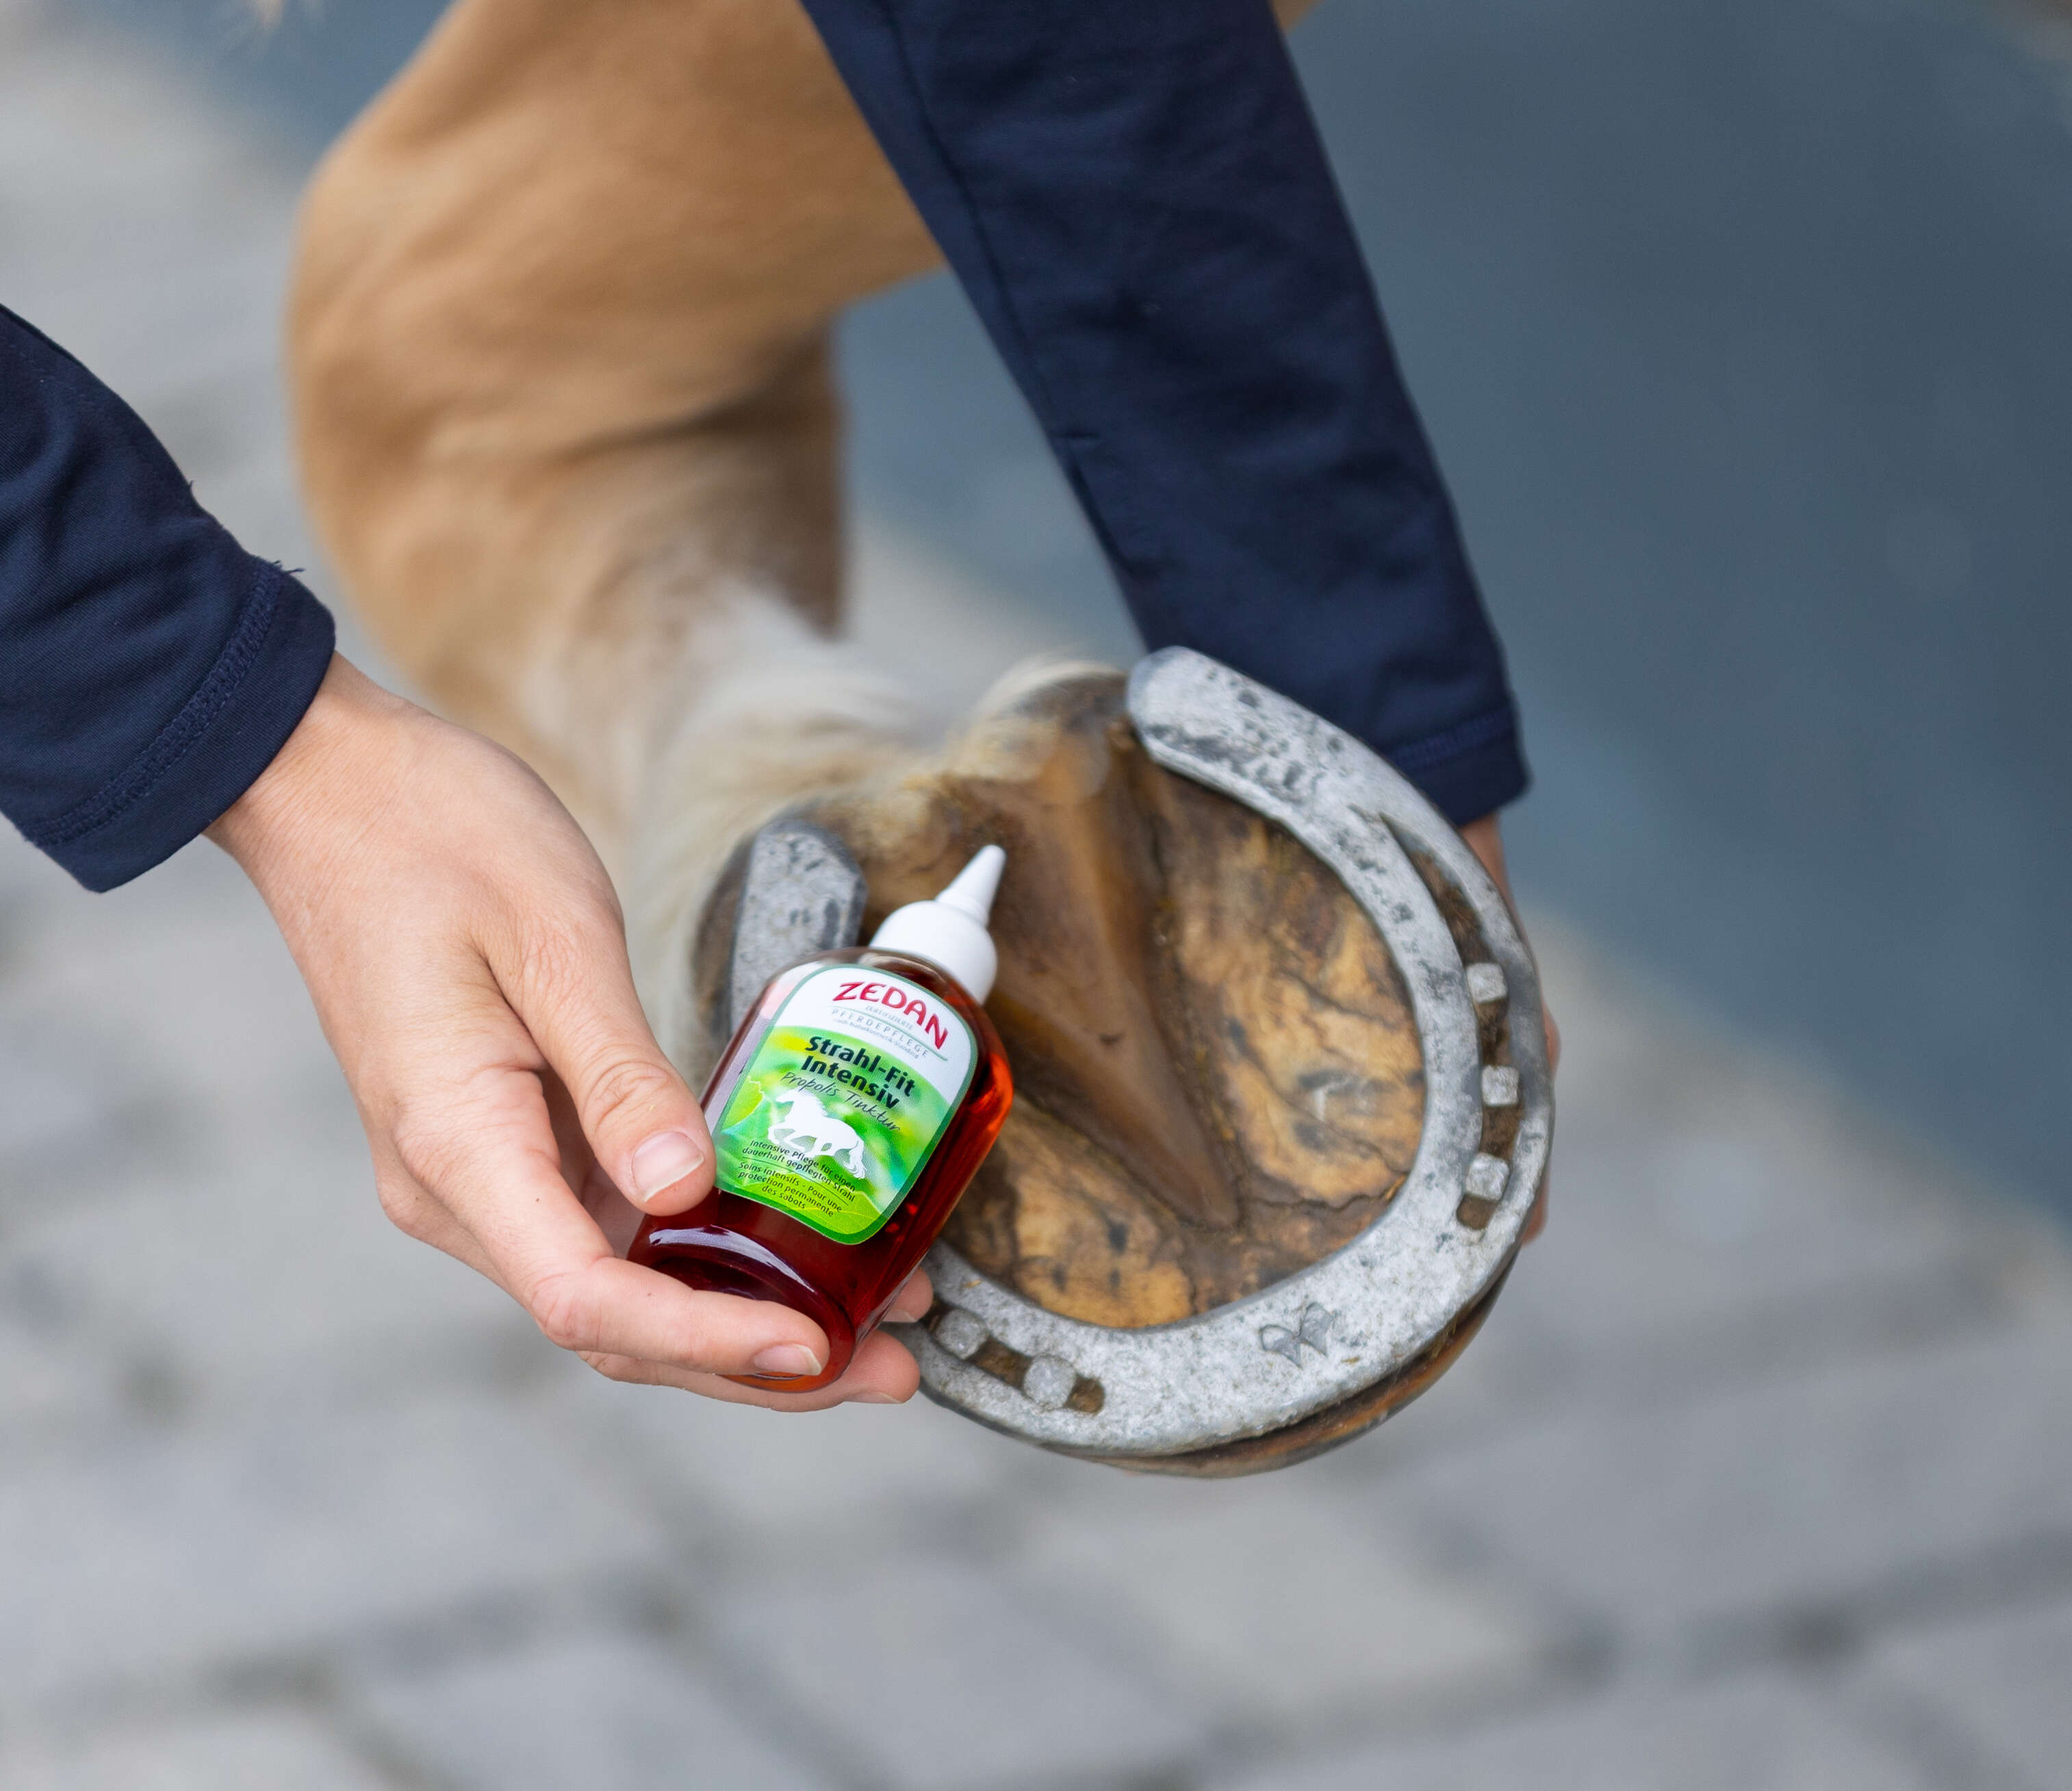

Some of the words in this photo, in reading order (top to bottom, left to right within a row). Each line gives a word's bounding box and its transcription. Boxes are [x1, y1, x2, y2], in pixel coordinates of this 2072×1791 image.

[832, 981, 949, 1049] ZEDAN
[832, 1008, 929, 1057] PFERDEPFLEGE
[801, 1055, 899, 1109] Intensiv
[805, 1035, 915, 1097] Strahl-Fit
[780, 1072, 840, 1096] Propolis
[844, 1090, 901, 1131] Tinktur
[739, 1161, 761, 1172] Soins
[763, 1168, 800, 1187] intensifs
[807, 1185, 827, 1202] Pour
[827, 1198, 843, 1212] une
[742, 1146, 786, 1163] dauerhaft
[786, 1159, 832, 1186] gepflegten
[832, 1182, 856, 1202] Strahl
[750, 1139, 791, 1157] Intensive
[791, 1150, 819, 1168] Pflege
[821, 1162, 834, 1176] für
[834, 1172, 856, 1192] einen
[738, 1171, 784, 1189] protection
[784, 1185, 834, 1217] permanente
[761, 1185, 777, 1196] des
[778, 1192, 806, 1210] sabots
